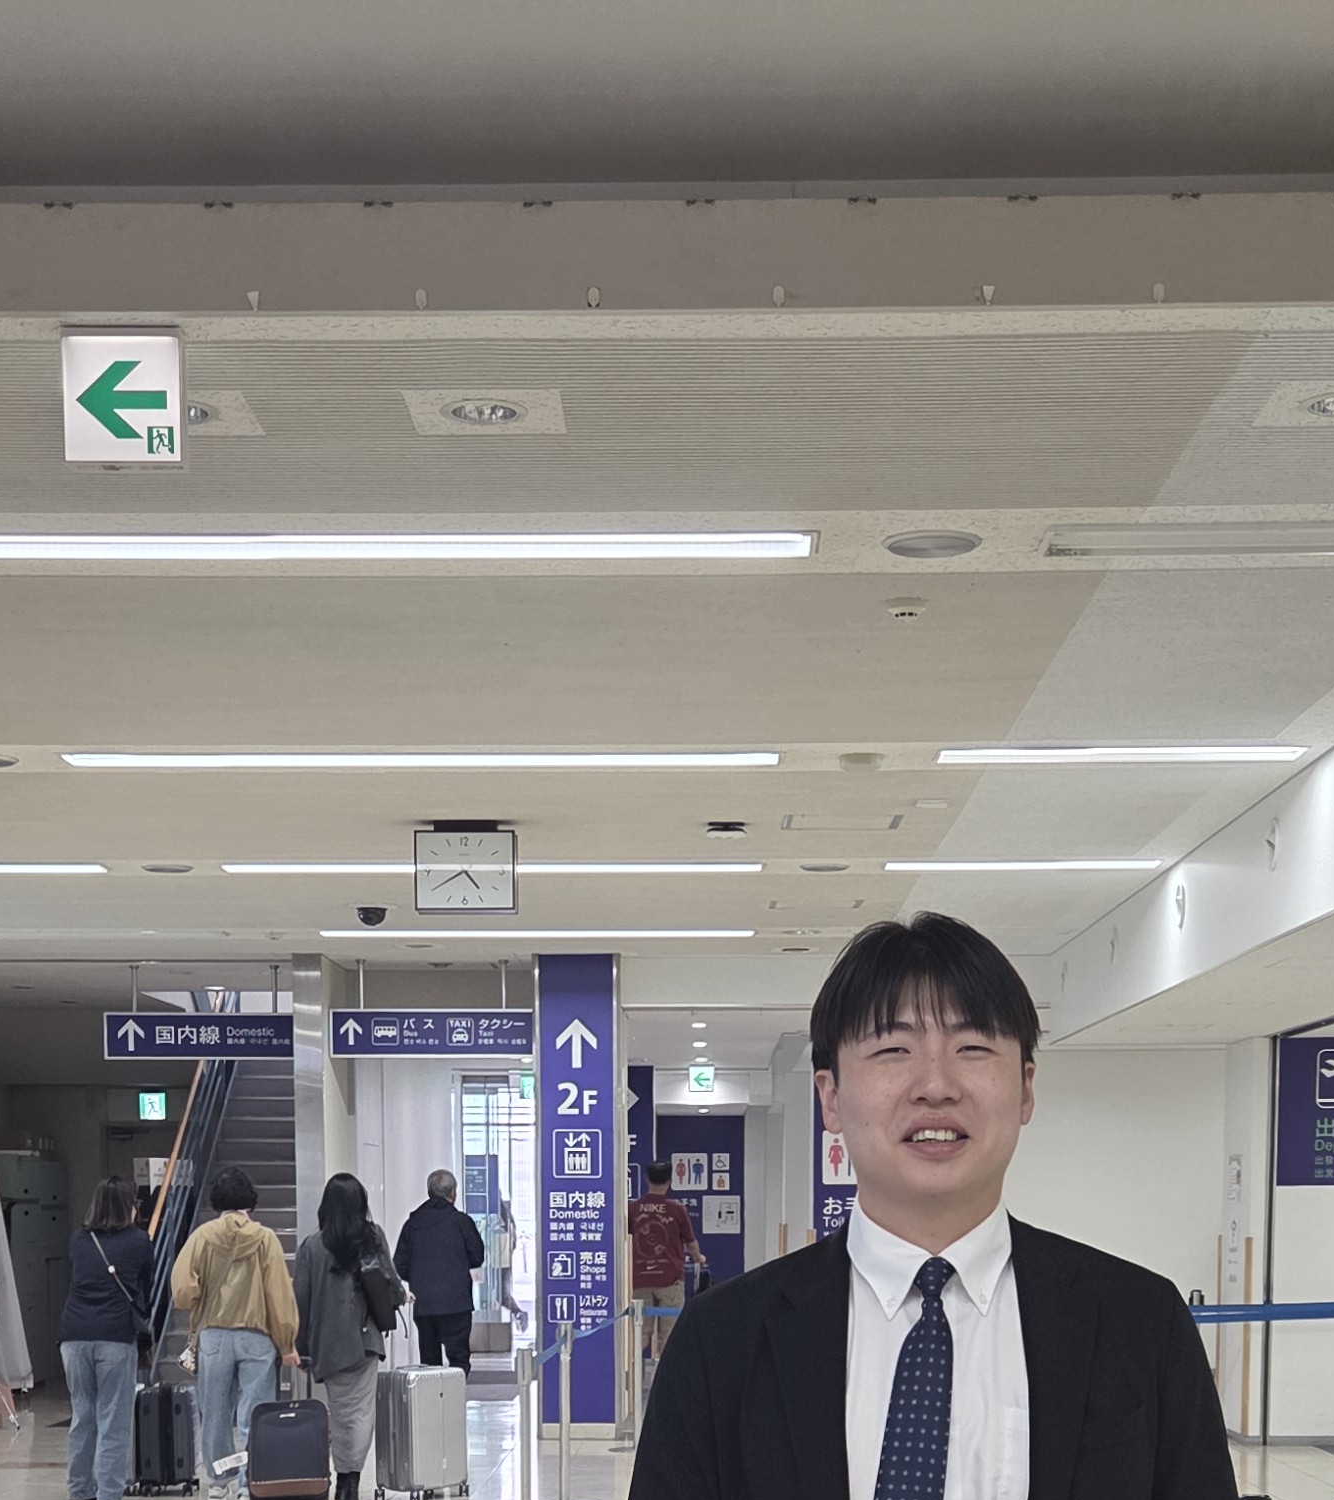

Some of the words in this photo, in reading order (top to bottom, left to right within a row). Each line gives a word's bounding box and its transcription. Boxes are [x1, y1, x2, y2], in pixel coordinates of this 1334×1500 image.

[459, 836, 469, 847] 12
[403, 1018, 435, 1030] バス
[449, 1020, 471, 1028] TAXI
[478, 1018, 525, 1030] タクシー
[155, 1025, 220, 1045] 国内線
[226, 1026, 275, 1037] Domestic
[557, 1082, 598, 1115] 2F
[549, 1191, 606, 1209] 国内線
[549, 1209, 600, 1219] Domestic
[640, 1203, 666, 1213] NIKE
[579, 1252, 607, 1264] 売店
[580, 1265, 606, 1274] Shops
[579, 1295, 608, 1307] レストラン
